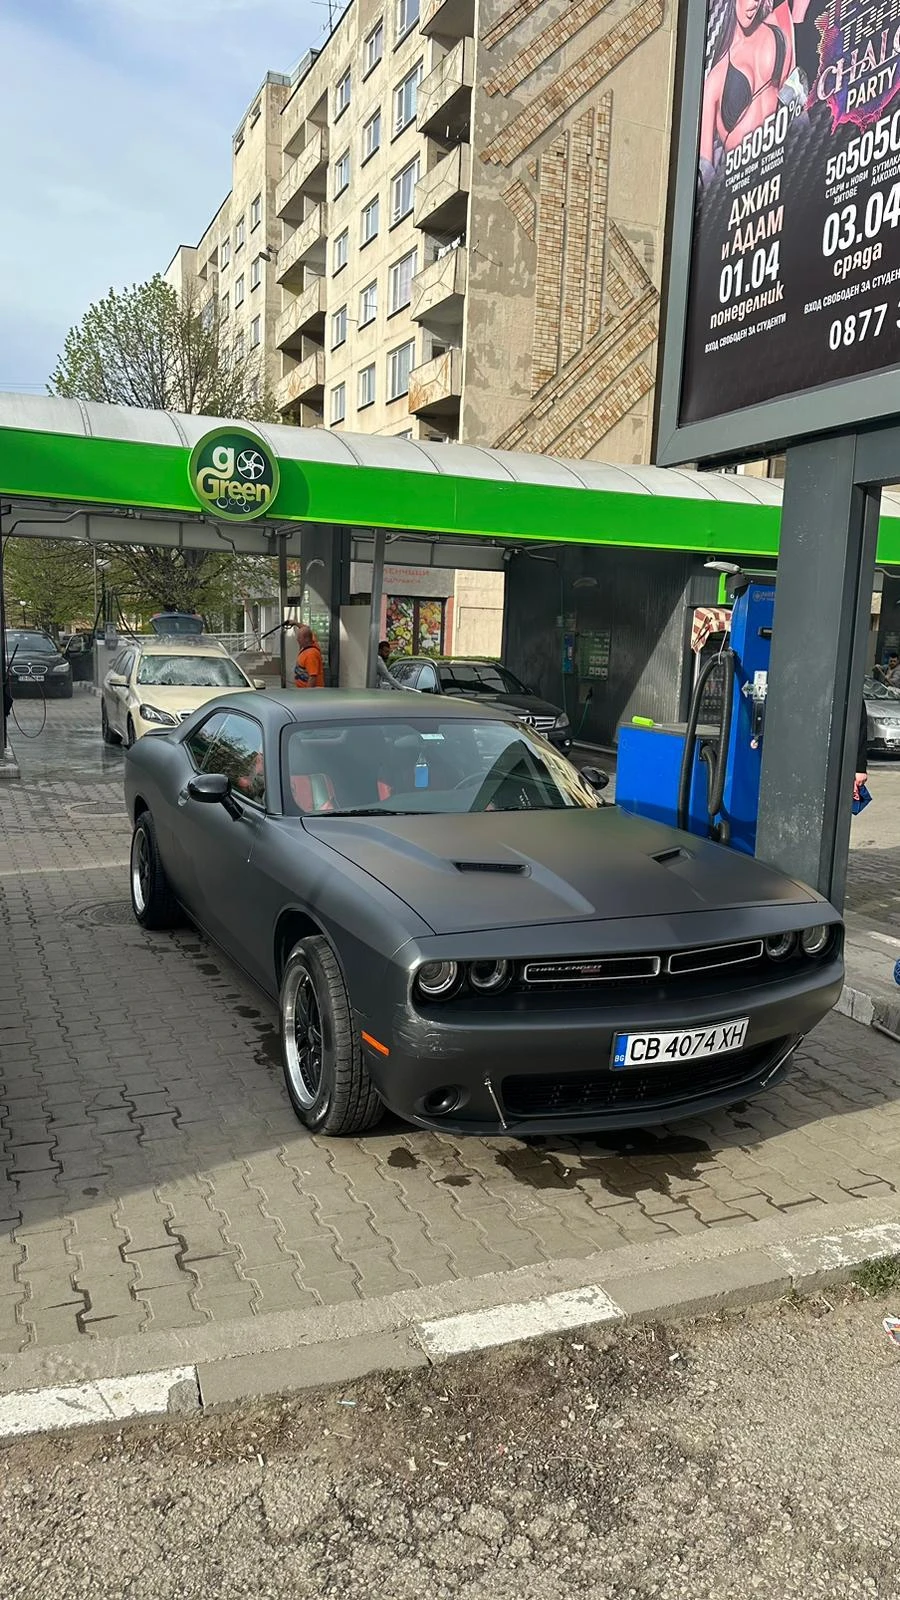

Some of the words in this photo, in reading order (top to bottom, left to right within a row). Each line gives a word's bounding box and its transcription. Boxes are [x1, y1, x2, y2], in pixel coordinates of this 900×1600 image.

[846, 63, 897, 113] PARTY
[725, 172, 741, 187] СТАРИ
[745, 161, 759, 176] НОВИ
[760, 156, 784, 176] АЛКОХОЛ
[761, 146, 785, 166] БУТИЛКА
[728, 173, 782, 231] ДЖИЯ
[731, 175, 751, 193] ХИТОВЕ
[825, 181, 845, 199] СТАРИ
[845, 181, 850, 190] и
[850, 169, 869, 187] НОВИ
[833, 186, 858, 206] ХИТОВЕ
[731, 204, 784, 255] АДАМ
[822, 181, 900, 257] 03.04
[719, 241, 780, 304] 01.04
[833, 242, 883, 280] сряда
[709, 281, 784, 330] понеделник
[803, 298, 822, 315] ВХОД
[822, 283, 860, 307] СВОБОДЕН
[861, 279, 871, 293] ЗА
[704, 339, 719, 353] ВХОД
[719, 328, 748, 348] СВОБОДЕН
[748, 324, 757, 336] ЗА
[757, 313, 787, 333] СТУДЕНТИ
[829, 302, 888, 351] 0877
[197, 467, 271, 503] Green
[614, 1054, 625, 1063] BG
[630, 1036, 660, 1061] CB
[665, 1031, 717, 1058] 4074
[719, 1024, 744, 1050] XH
